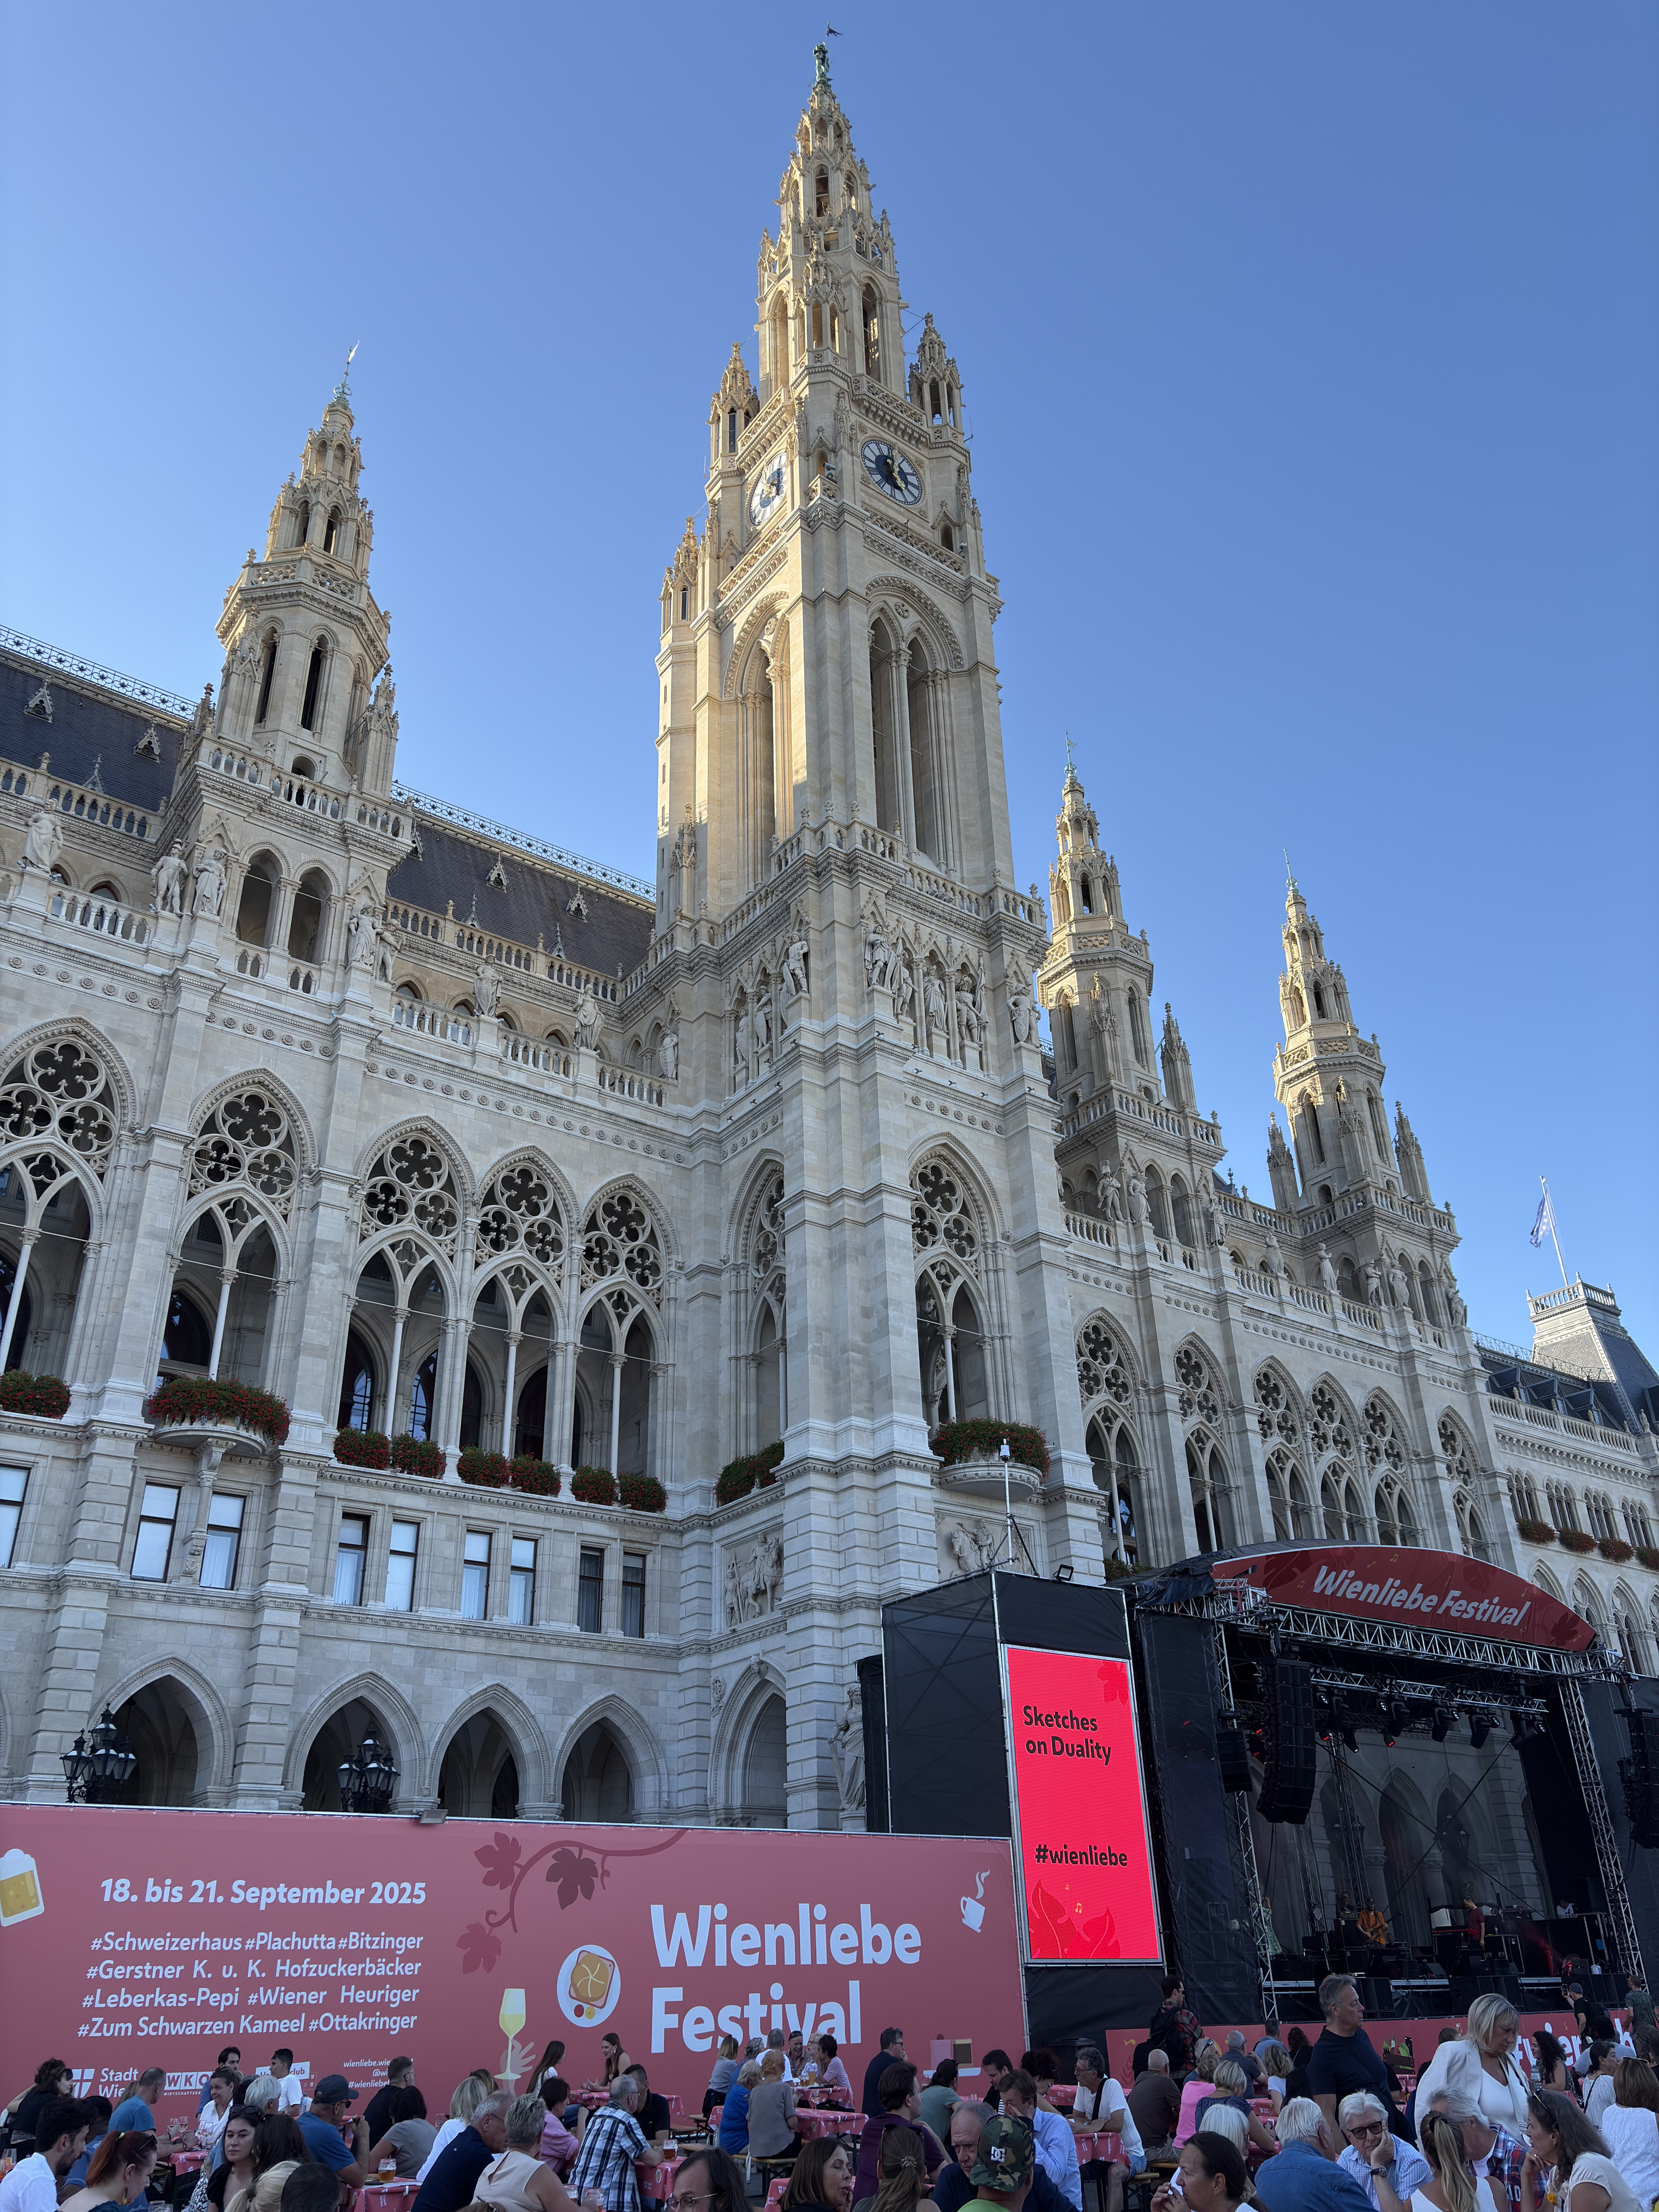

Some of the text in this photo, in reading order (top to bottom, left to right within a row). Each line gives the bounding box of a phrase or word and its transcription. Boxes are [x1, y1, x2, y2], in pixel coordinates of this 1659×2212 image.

[1313, 1566, 1531, 1626] Wienliebe Festival
[1023, 1705, 1098, 1731] Sketches
[1026, 1736, 1111, 1766] on Duality
[1035, 1844, 1128, 1867] #wienliebe
[101, 1878, 426, 1910] 18. bis 21. September 2025
[91, 1931, 424, 1953] #Schweizerhaus #Plachutta #Bitzinger
[650, 1903, 921, 1967] Wienliebe
[86, 1957, 422, 1979] #Gerstner K. u. K. Hofzuckerbäcker
[82, 1985, 420, 2012] #Leberkas-Pepi #Wiener Heuriger
[77, 2011, 418, 2037] #Zum Schwarzen Kameel #Ottakringer
[651, 1980, 862, 2053] Festival
[100, 2067, 139, 2082] Stadt
[98, 2083, 126, 2098] Wie
